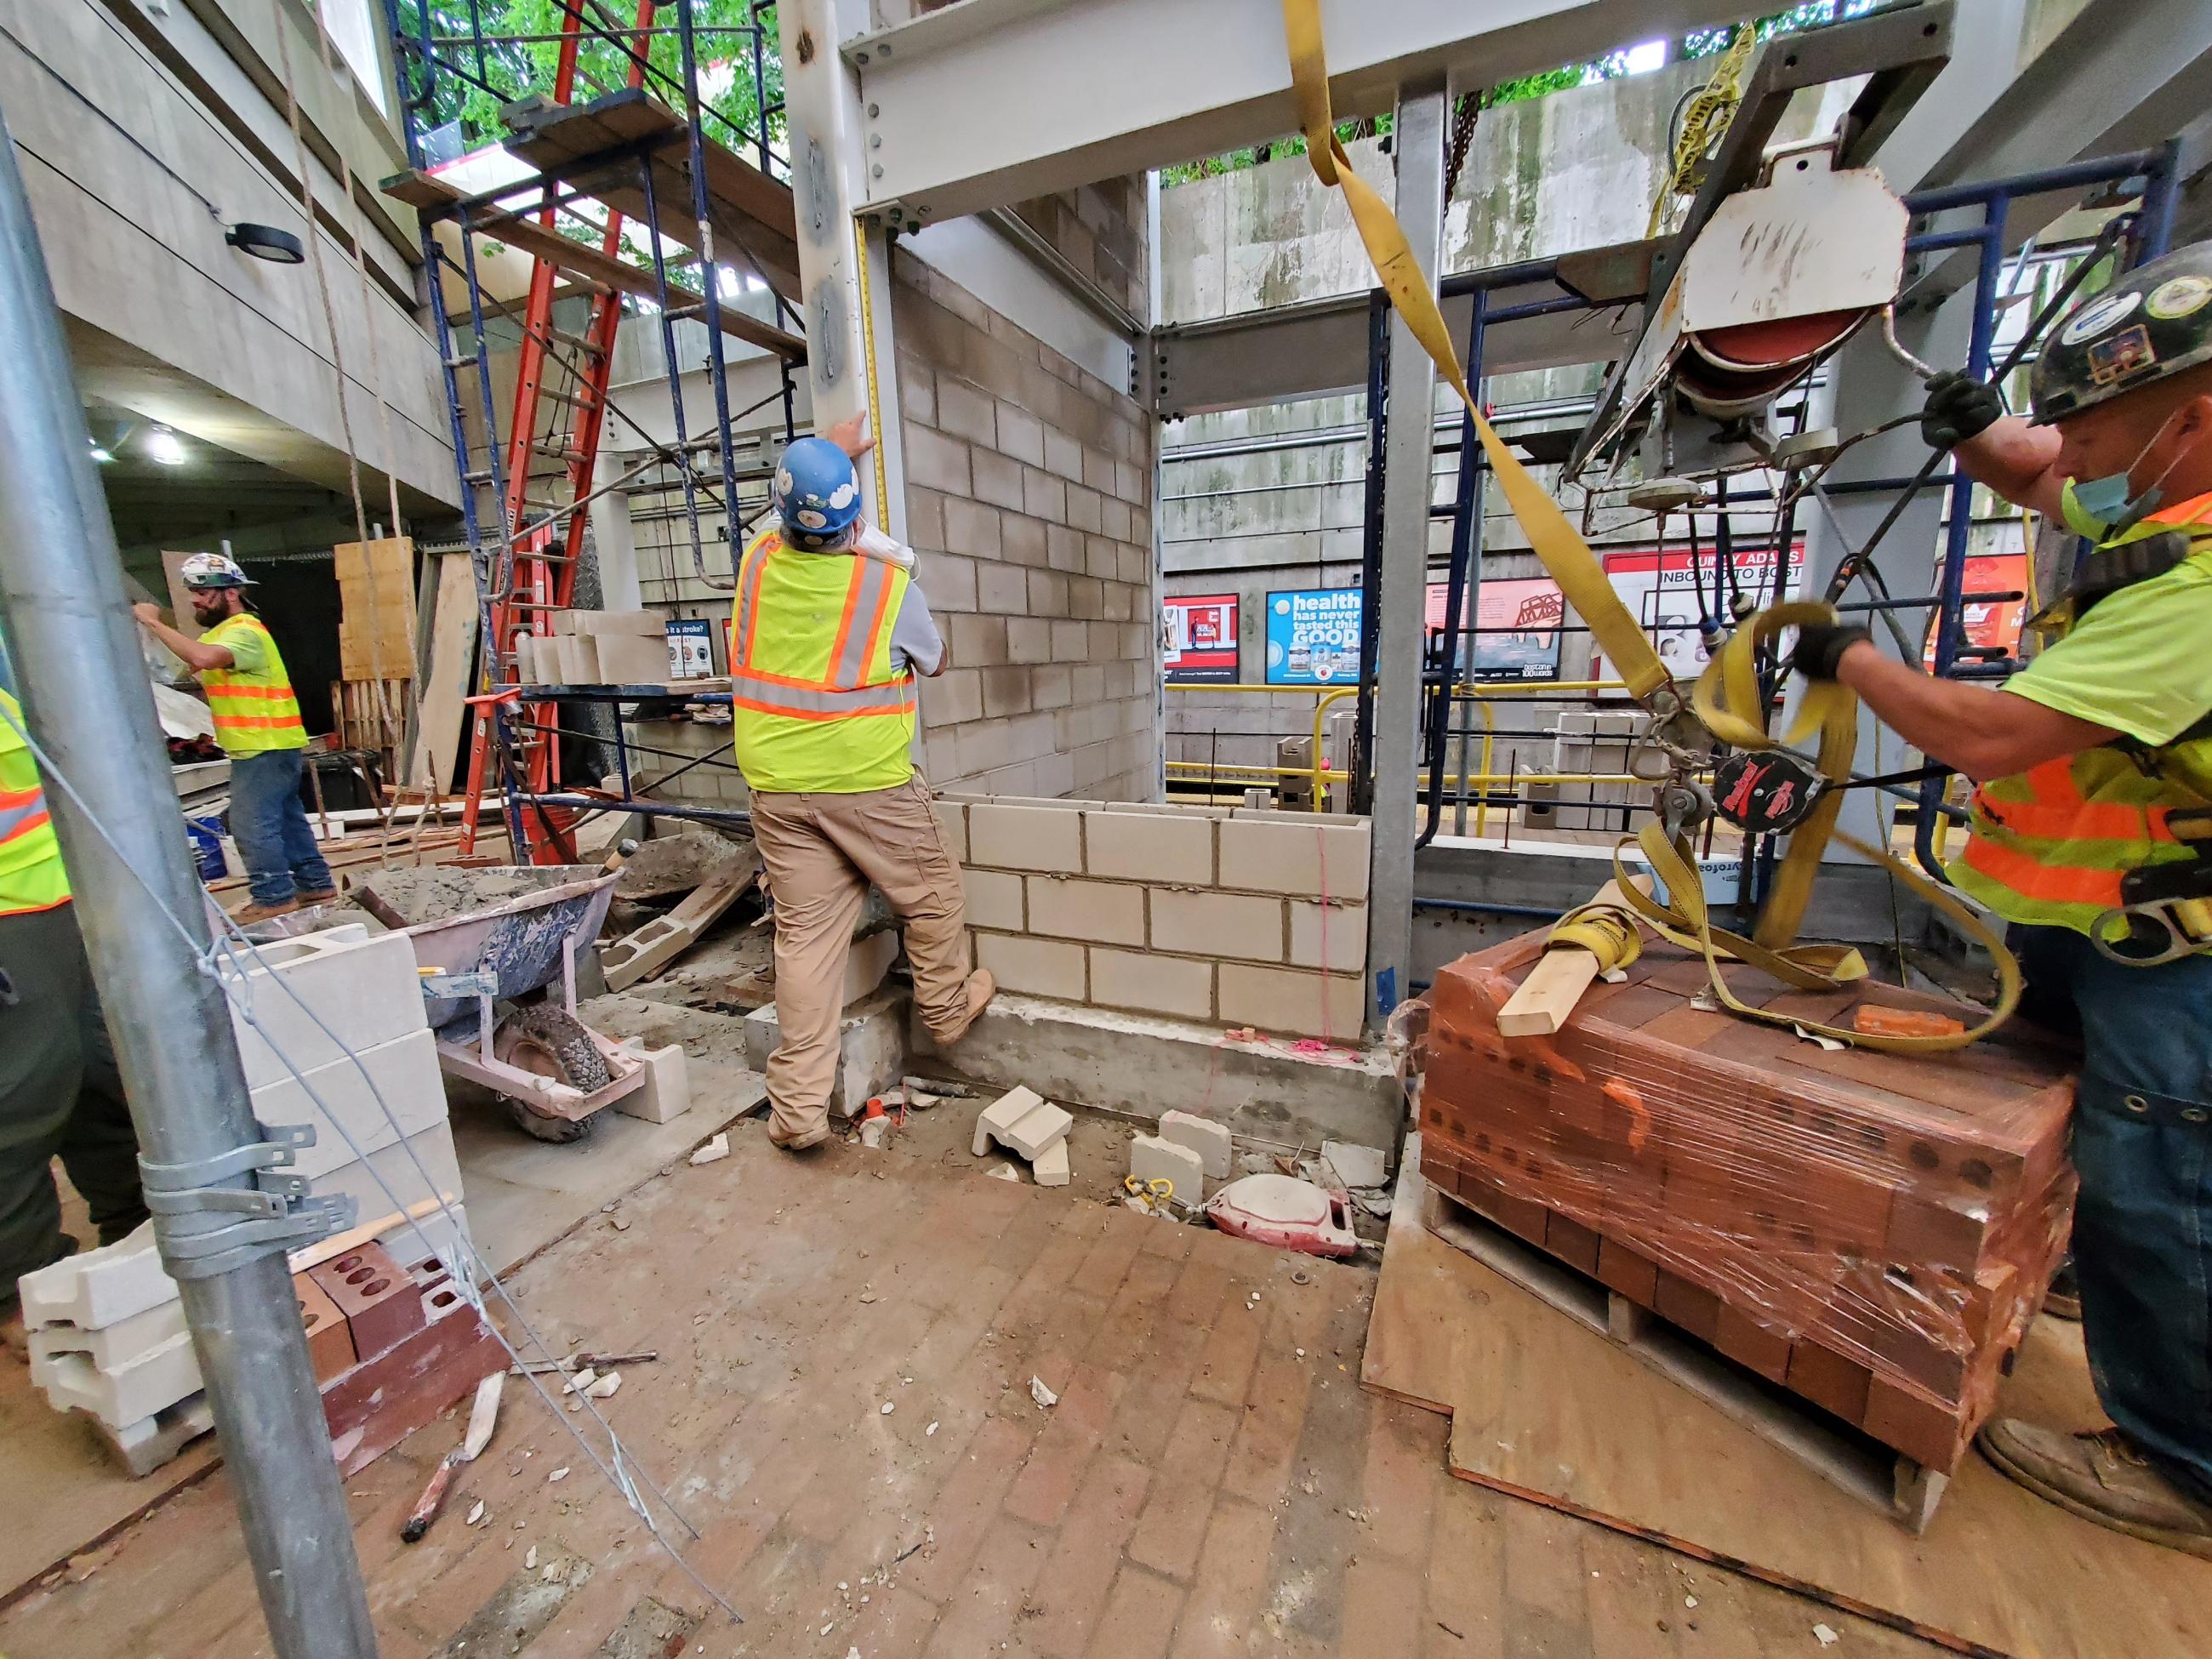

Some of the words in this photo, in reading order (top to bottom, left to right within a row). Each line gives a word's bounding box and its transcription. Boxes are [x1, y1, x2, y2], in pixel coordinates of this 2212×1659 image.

[1745, 551, 1799, 565] ADAS
[1735, 567, 1753, 579] TO
[1293, 592, 1360, 610] health
[1293, 611, 1316, 620] has
[1319, 611, 1360, 619] never
[1293, 620, 1332, 630] tasted
[1336, 619, 1359, 629] this
[1293, 629, 1359, 645] GOOD
